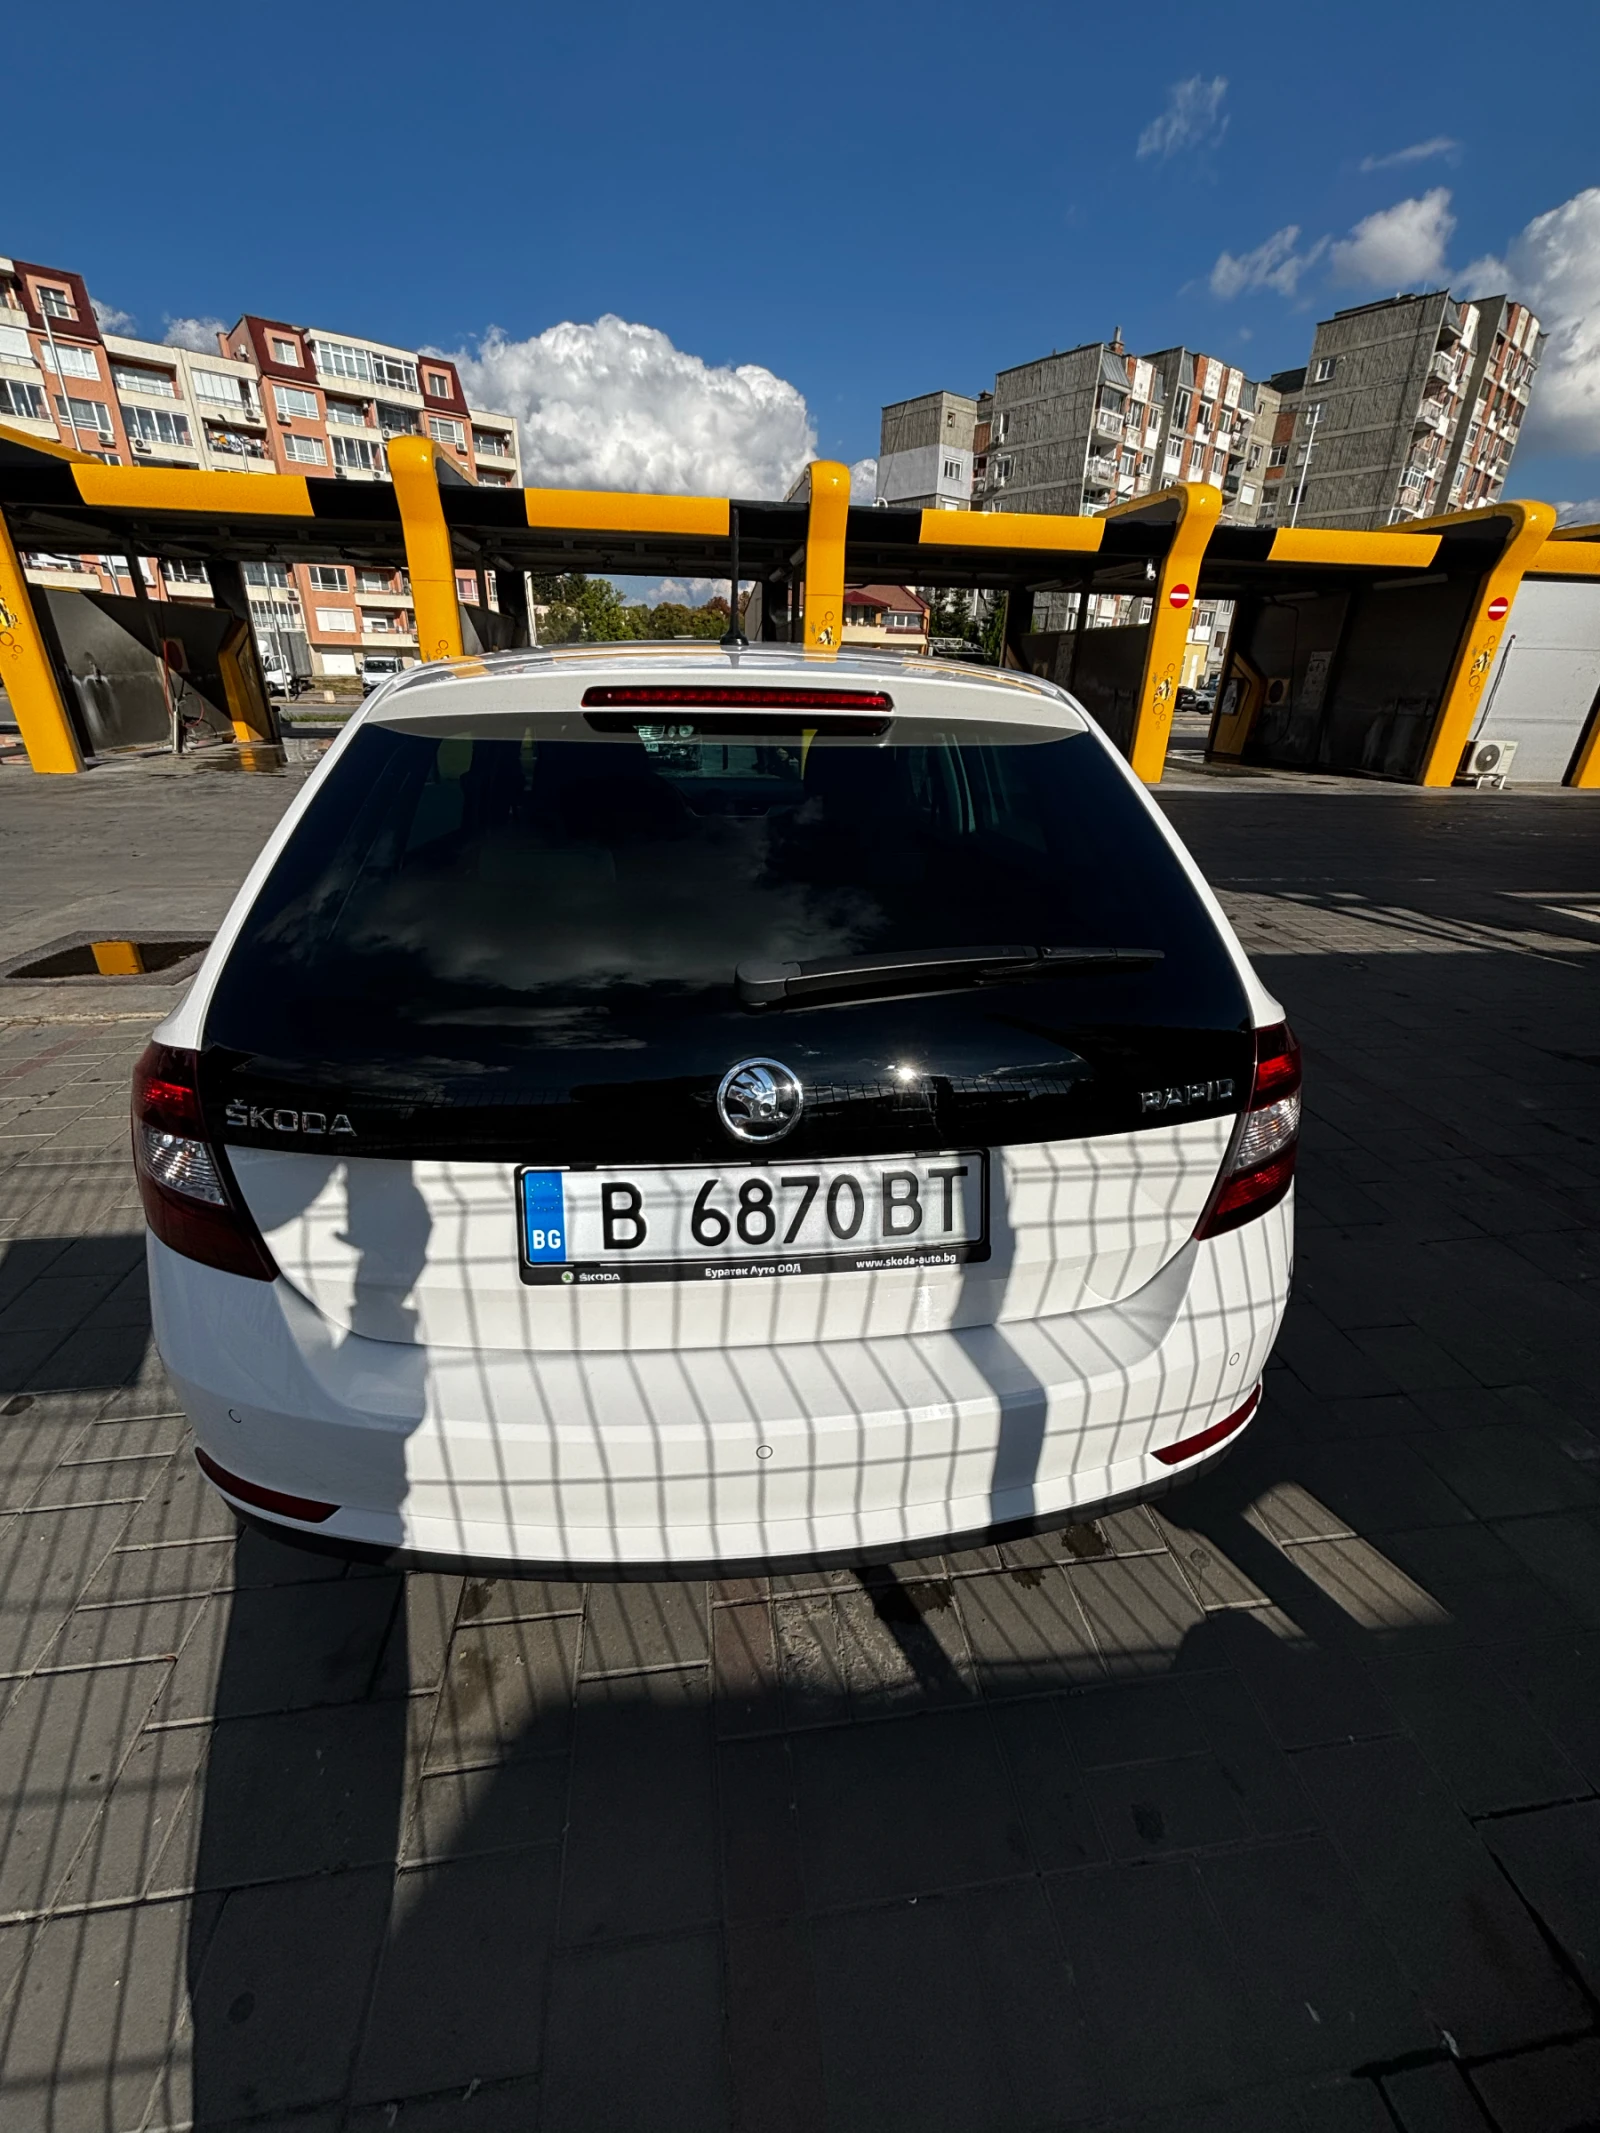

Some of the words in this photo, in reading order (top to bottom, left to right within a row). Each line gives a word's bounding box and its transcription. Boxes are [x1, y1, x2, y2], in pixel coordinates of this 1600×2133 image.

[1137, 1079, 1236, 1113] RAPID
[225, 1098, 358, 1137] ŠKODA
[601, 1181, 647, 1250] B
[691, 1173, 865, 1247] 6870
[882, 1166, 968, 1237] BT
[532, 1229, 561, 1250] BG
[705, 1267, 749, 1279] Еуратек
[750, 1265, 776, 1277] Ауто
[777, 1263, 802, 1274] ООД
[855, 1252, 957, 1269] www.skoda-auto.bg
[579, 1272, 621, 1282] ŠKODA
